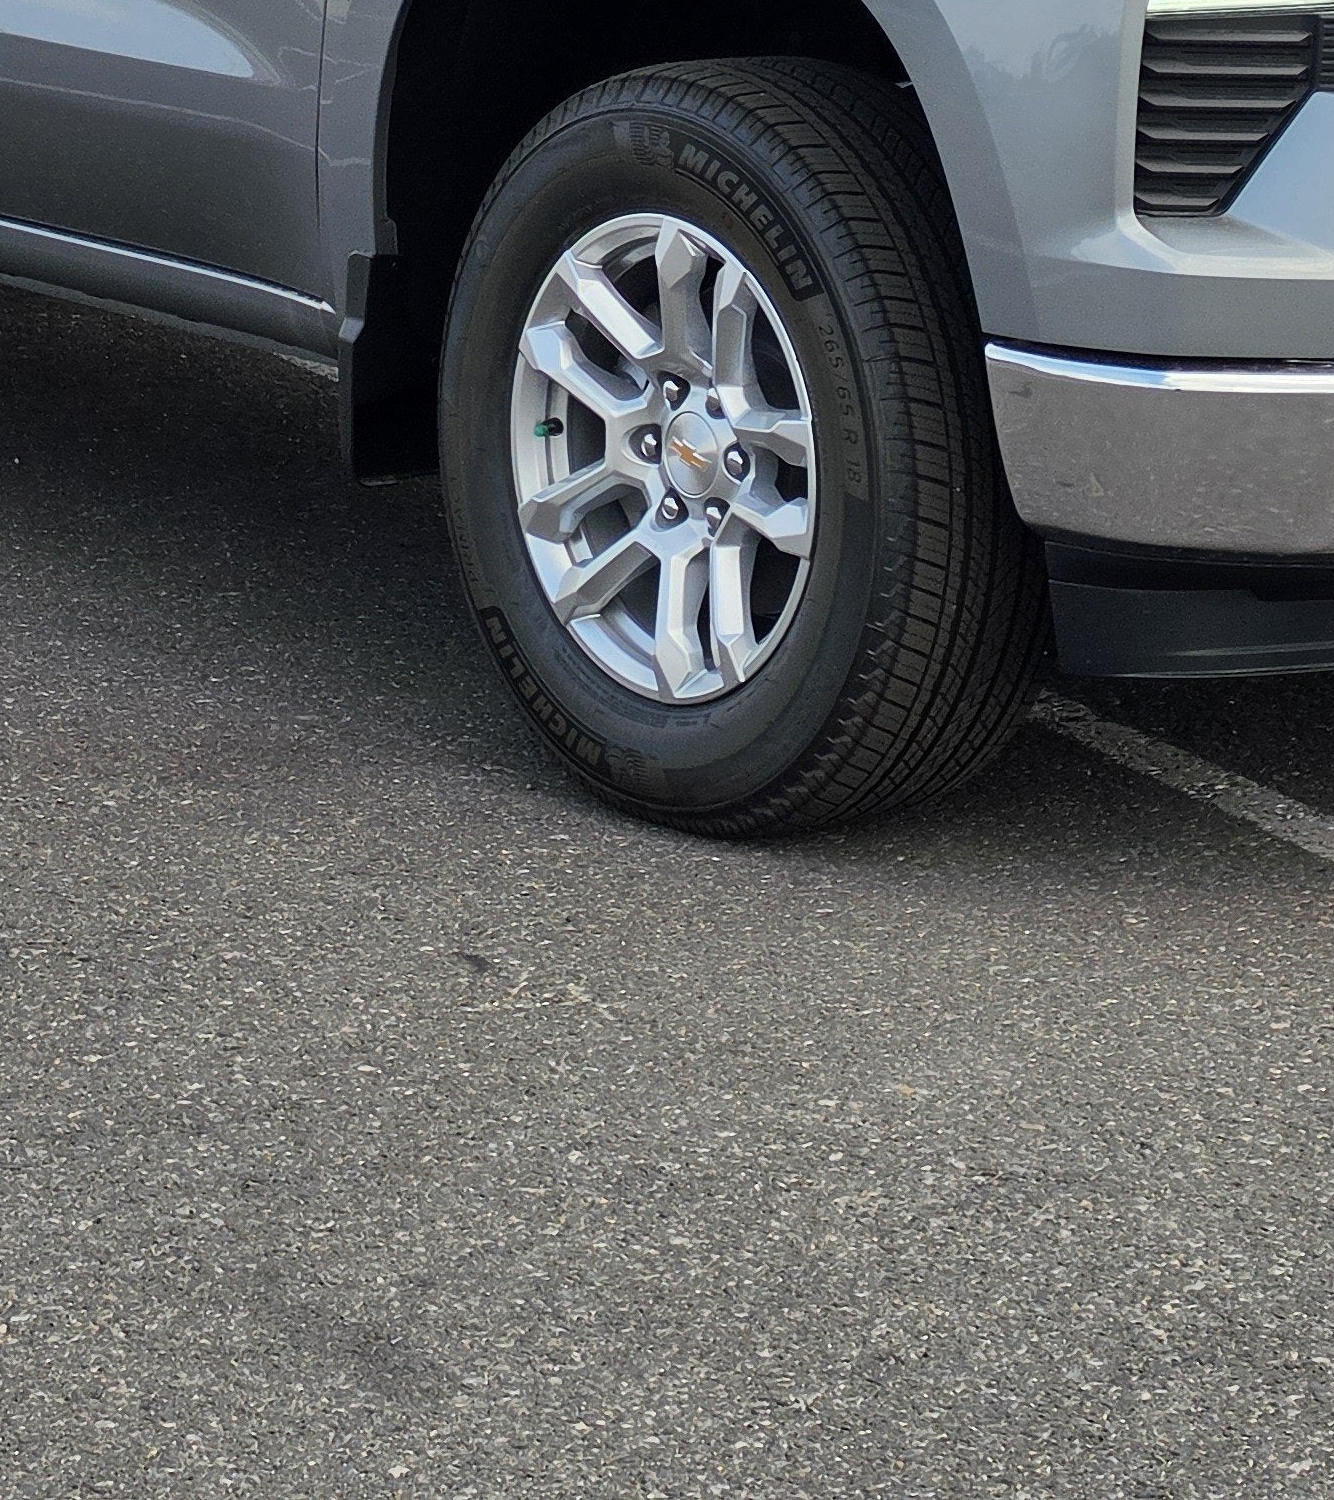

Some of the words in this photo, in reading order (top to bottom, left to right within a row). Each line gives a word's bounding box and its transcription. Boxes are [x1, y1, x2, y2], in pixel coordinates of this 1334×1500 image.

[678, 143, 813, 292] MICHELIN
[818, 324, 855, 417] 265/65
[485, 616, 603, 766] MICHELIN
